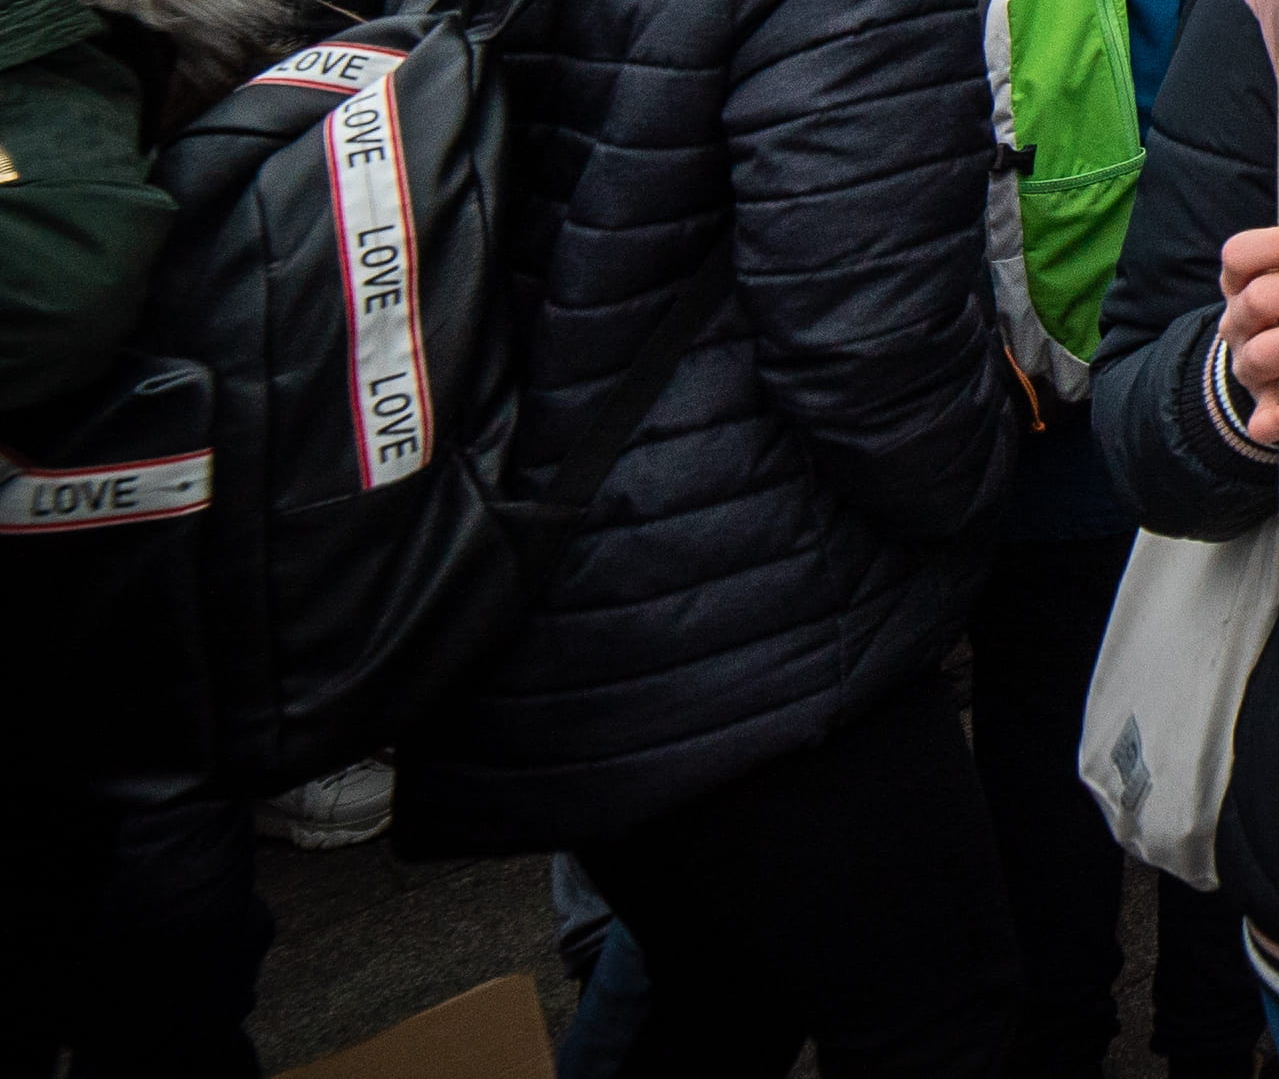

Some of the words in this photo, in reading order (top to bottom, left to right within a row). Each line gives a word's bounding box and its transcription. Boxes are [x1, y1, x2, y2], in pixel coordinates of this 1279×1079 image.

[277, 50, 369, 80] OVE
[343, 92, 385, 168] LOVE
[356, 224, 402, 314] LOVE
[366, 371, 420, 465] LOVE
[29, 476, 138, 518] LOVE
